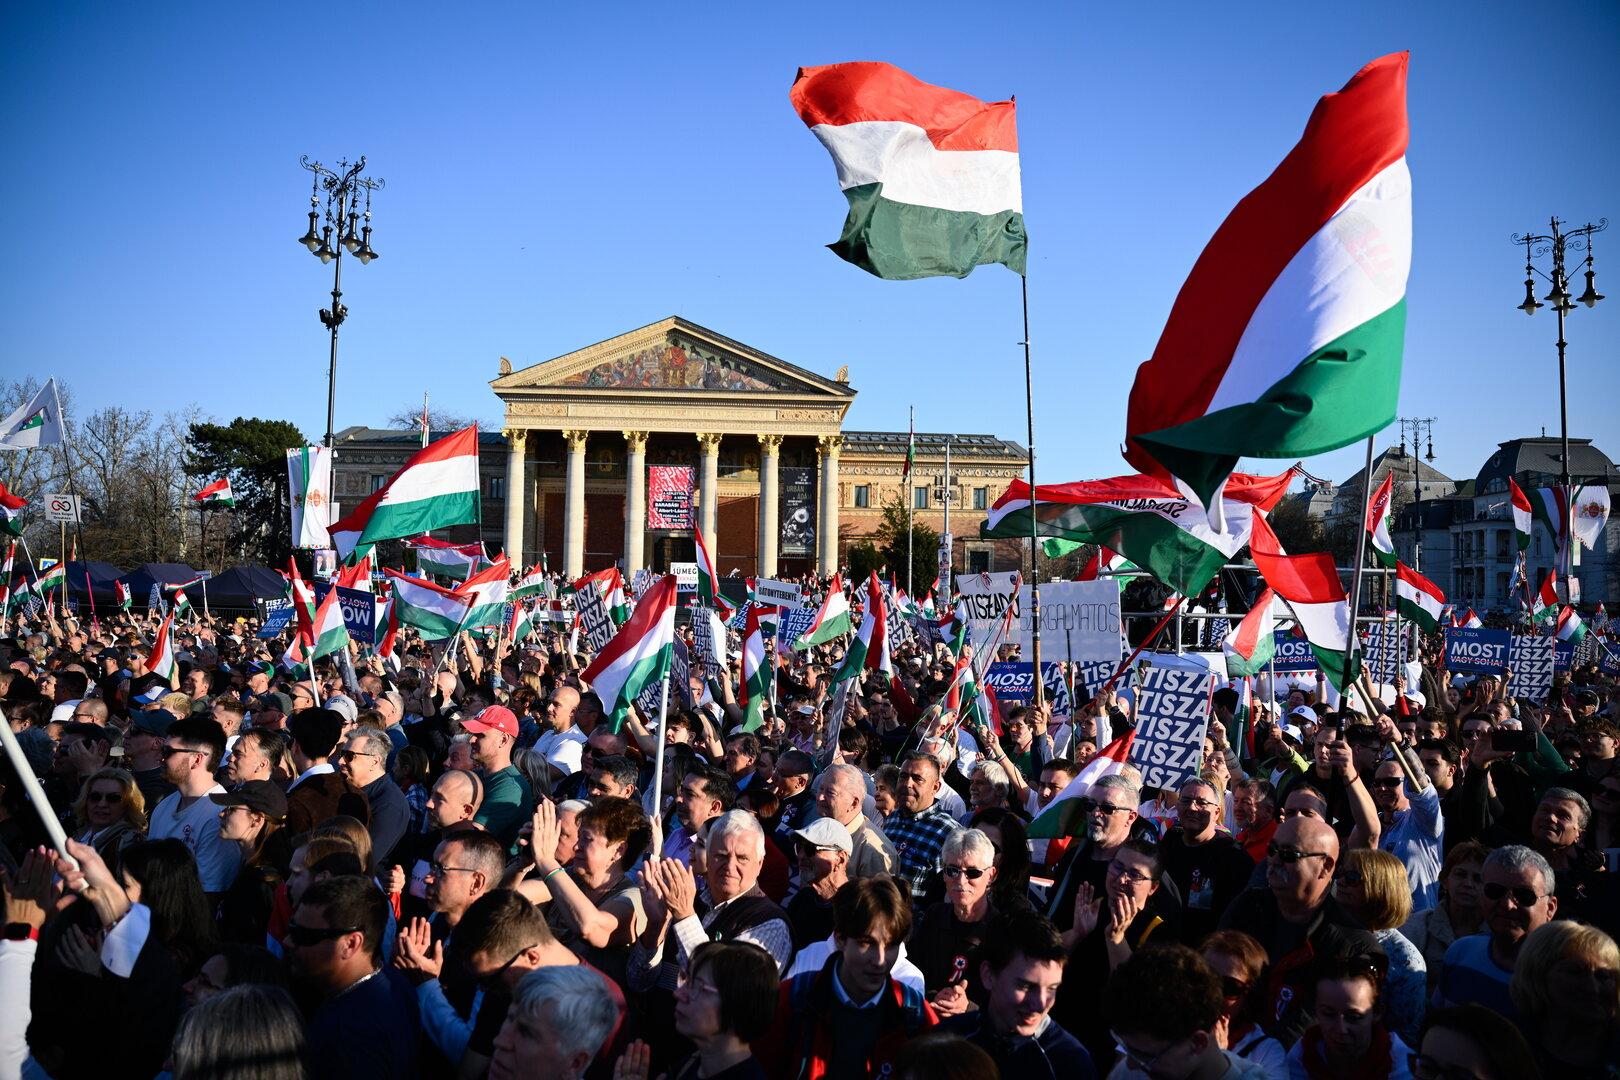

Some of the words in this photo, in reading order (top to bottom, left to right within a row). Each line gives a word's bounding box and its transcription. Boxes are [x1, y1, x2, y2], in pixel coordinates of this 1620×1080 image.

[573, 579, 600, 612] TISZA
[580, 600, 608, 631] TISZA
[788, 615, 815, 624] TISZA
[1019, 602, 1119, 633] SZRGALMATOS
[1450, 655, 1473, 664] VAGY
[1474, 657, 1503, 667] SOHA!
[1451, 641, 1505, 659] MOST
[1553, 651, 1569, 660] ST
[1143, 666, 1211, 696] TISZA
[1511, 673, 1552, 687] ISZA
[1138, 690, 1208, 720] TISZA
[1135, 713, 1206, 747] TISZA
[1131, 738, 1202, 771] TISZA
